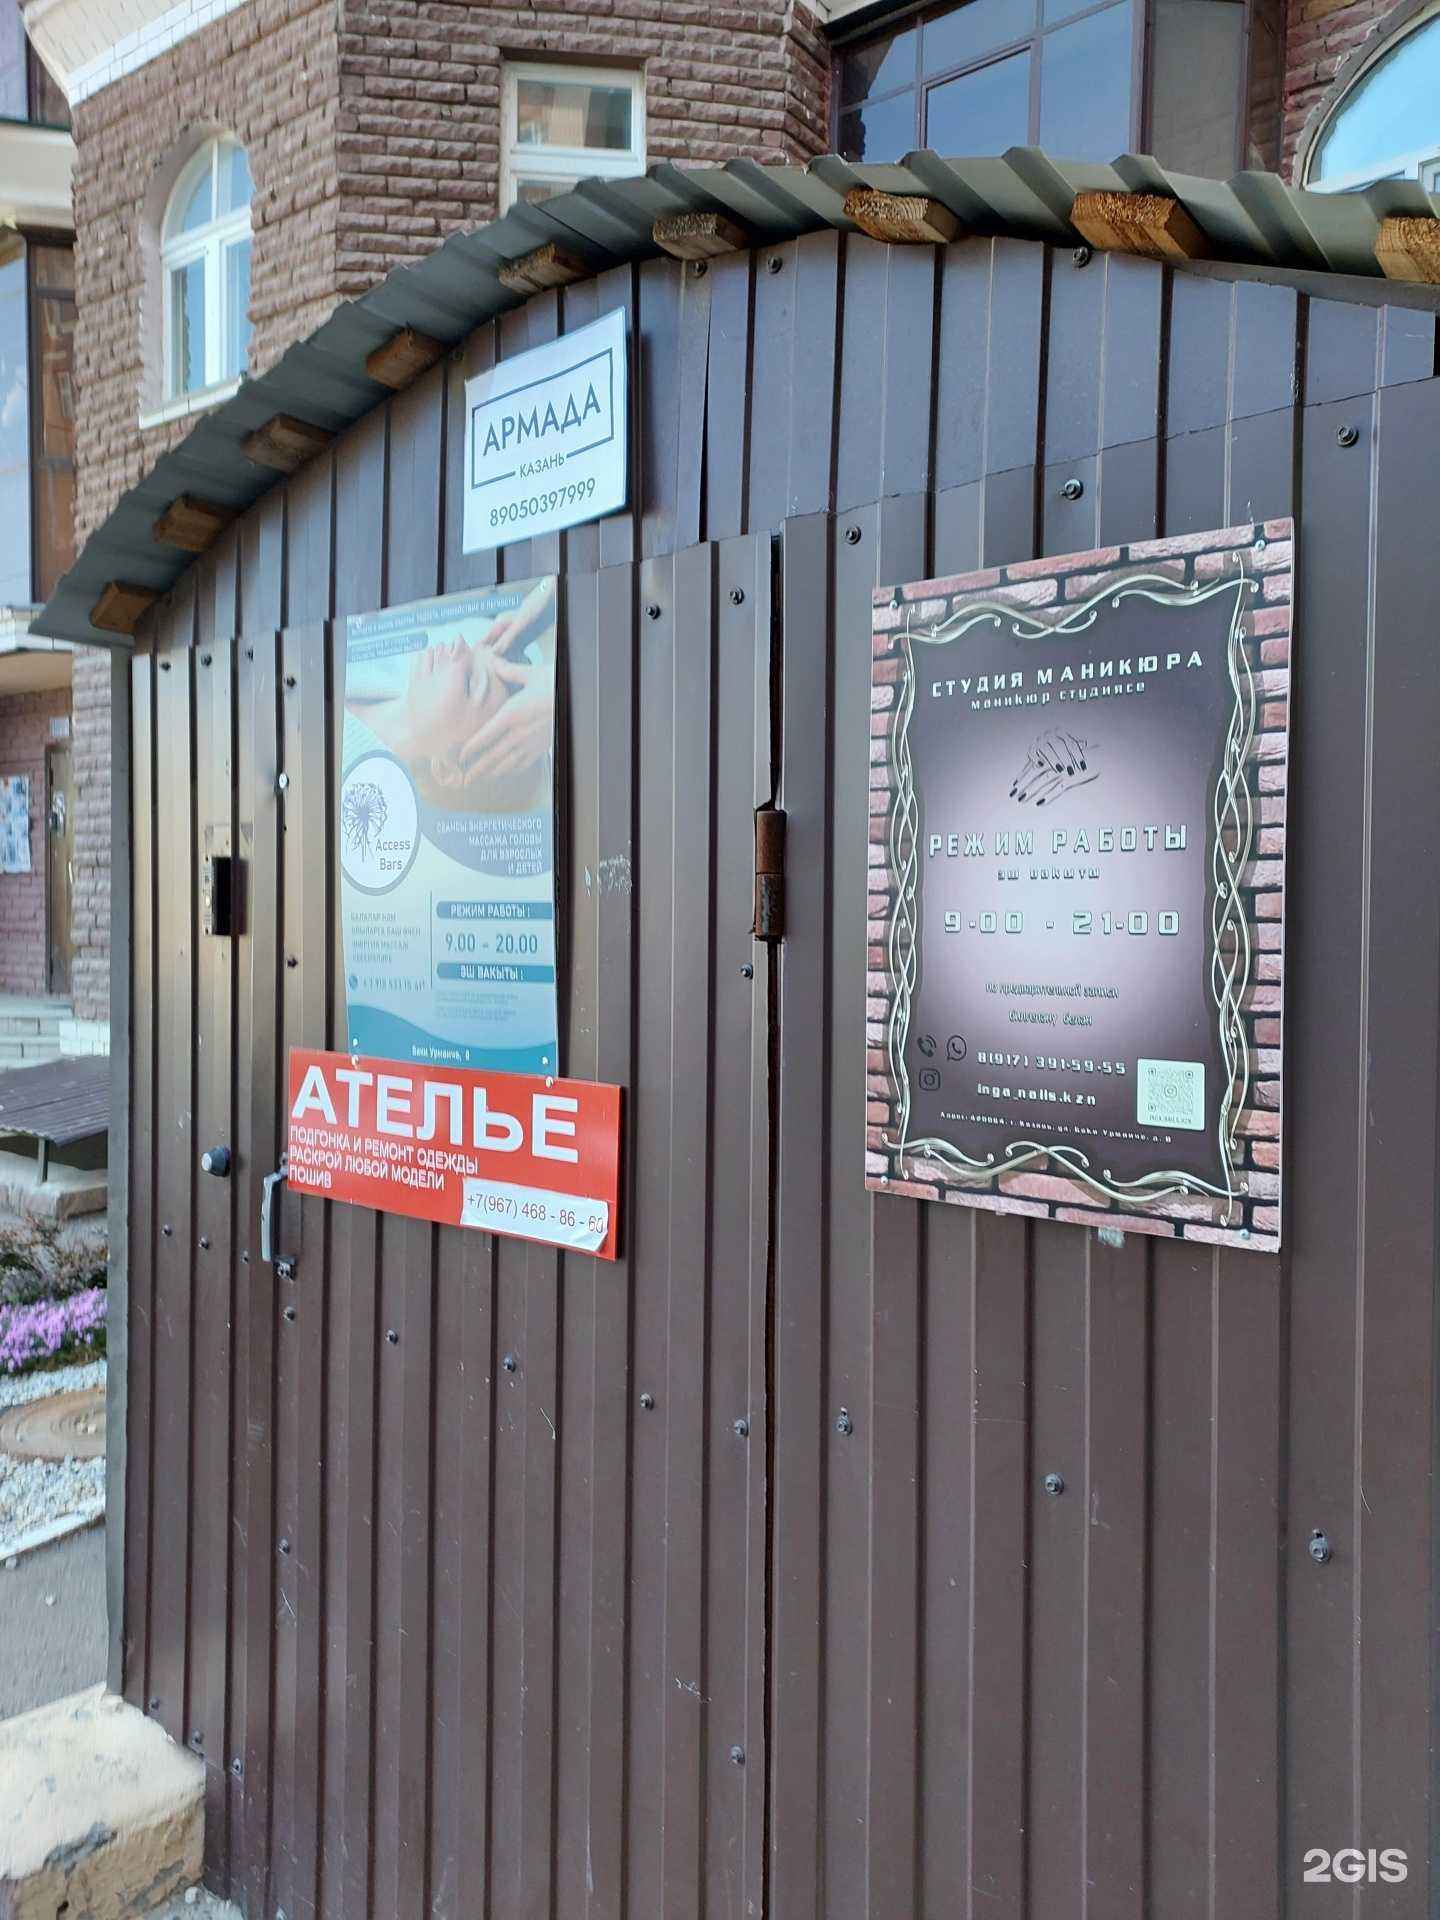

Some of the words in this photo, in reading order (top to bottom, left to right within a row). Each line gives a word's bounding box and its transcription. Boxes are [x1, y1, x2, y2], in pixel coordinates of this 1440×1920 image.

[483, 382, 601, 456] АРМАДА
[518, 452, 566, 478] КАЗАНЬ
[489, 477, 596, 527] 89050397999
[931, 671, 1024, 698] СТУДИЯ
[1037, 650, 1204, 685] МАНИКЮРА
[971, 692, 1051, 712] маникюр
[375, 839, 411, 852] Access
[929, 830, 1034, 858] РЕЖИМ
[1052, 824, 1188, 855] РАБОТЫ
[379, 858, 403, 871] Bars
[450, 903, 485, 918] РЕЖИМ
[445, 932, 476, 952] 9.00
[495, 934, 538, 955] 20.00
[977, 1051, 1029, 1068] 8(917)
[291, 1064, 580, 1165] АТЕЛЬЕ
[289, 1124, 351, 1151] ПОДГОНКА
[353, 1136, 361, 1150] И
[364, 1137, 415, 1163] РЕМОНТ
[416, 1148, 479, 1175] ОДЕЖДЫ
[289, 1144, 342, 1172] РАСКРОЙ
[344, 1153, 389, 1180] ЛЮБОЙ
[391, 1164, 445, 1191] МОДЕЛИ
[289, 1165, 332, 1189] ПОШИВ
[467, 1193, 518, 1220] +7(967)
[521, 1202, 547, 1222] 468
[559, 1209, 576, 1227] 86
